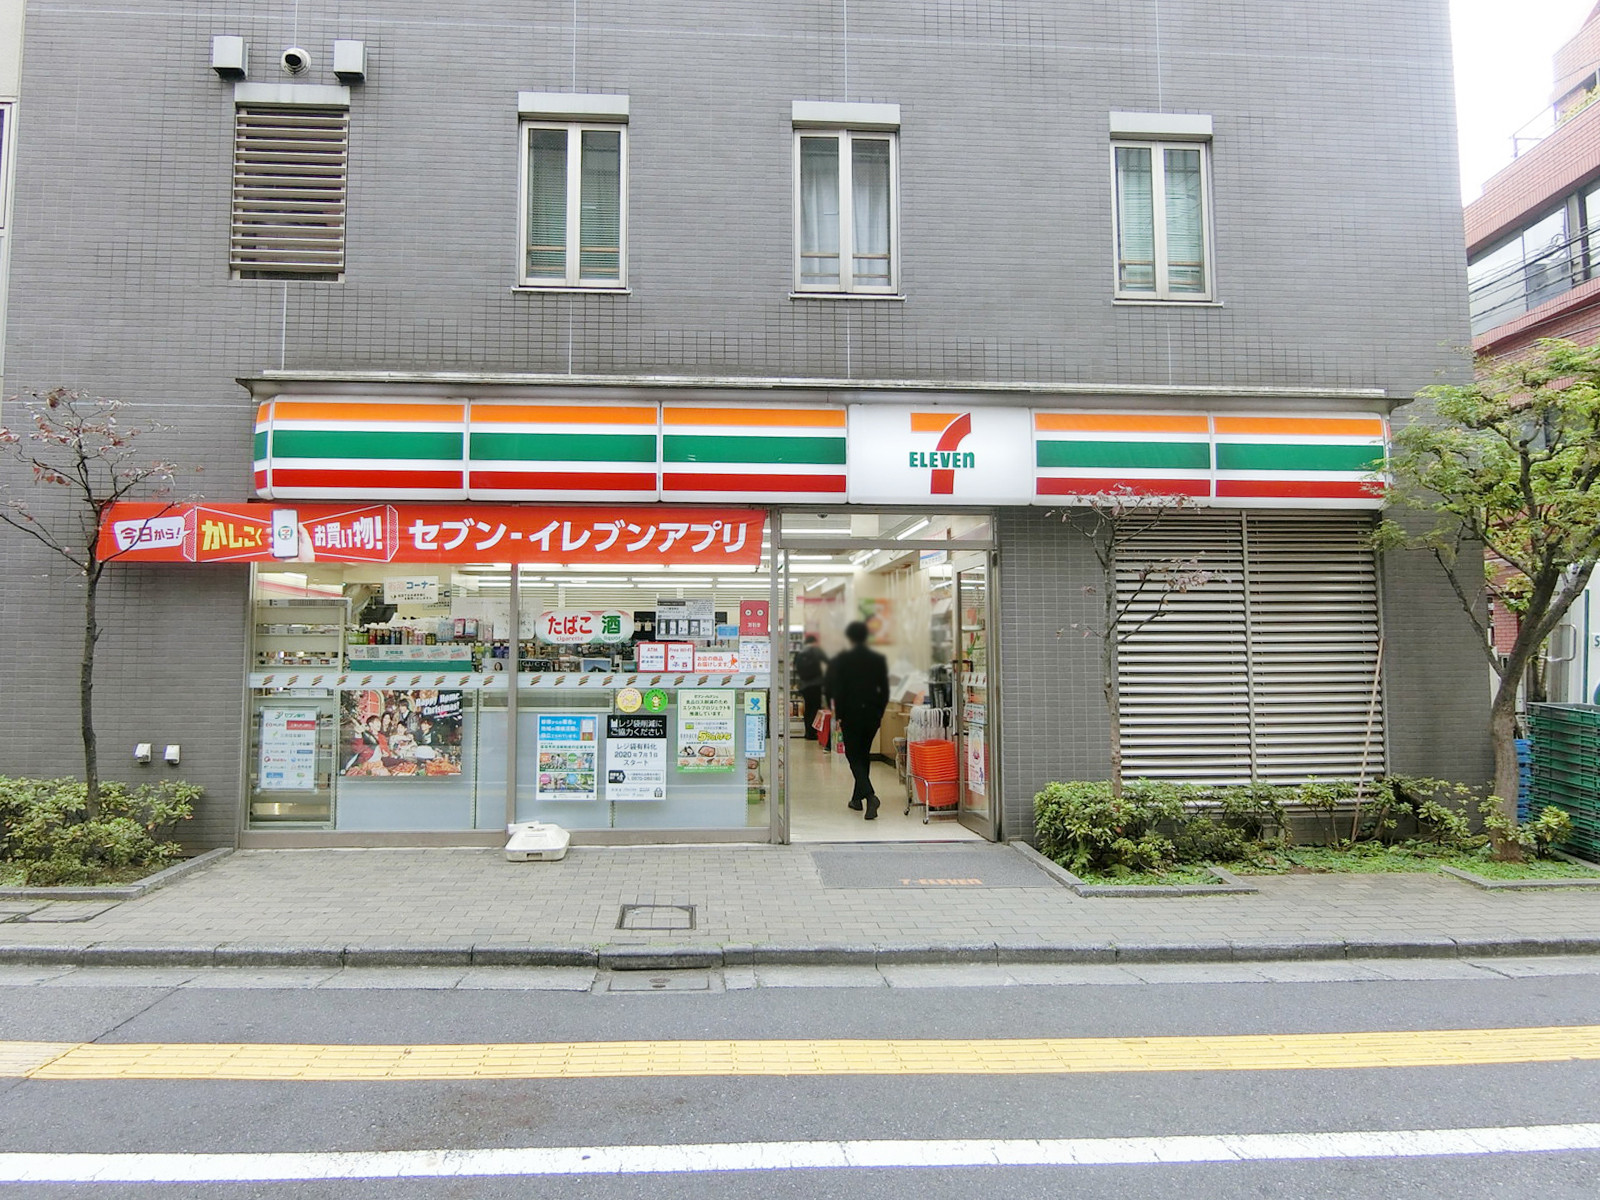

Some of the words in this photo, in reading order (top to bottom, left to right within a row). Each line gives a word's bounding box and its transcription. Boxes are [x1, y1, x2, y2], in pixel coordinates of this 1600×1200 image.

[910, 412, 972, 495] 7
[201, 519, 263, 551] かしこく
[408, 518, 747, 553] セブン-イレブンアプリ
[548, 616, 593, 635] たばこ
[601, 615, 621, 634] 酒
[415, 697, 438, 707] Happy
[610, 728, 664, 737] ご協力ください
